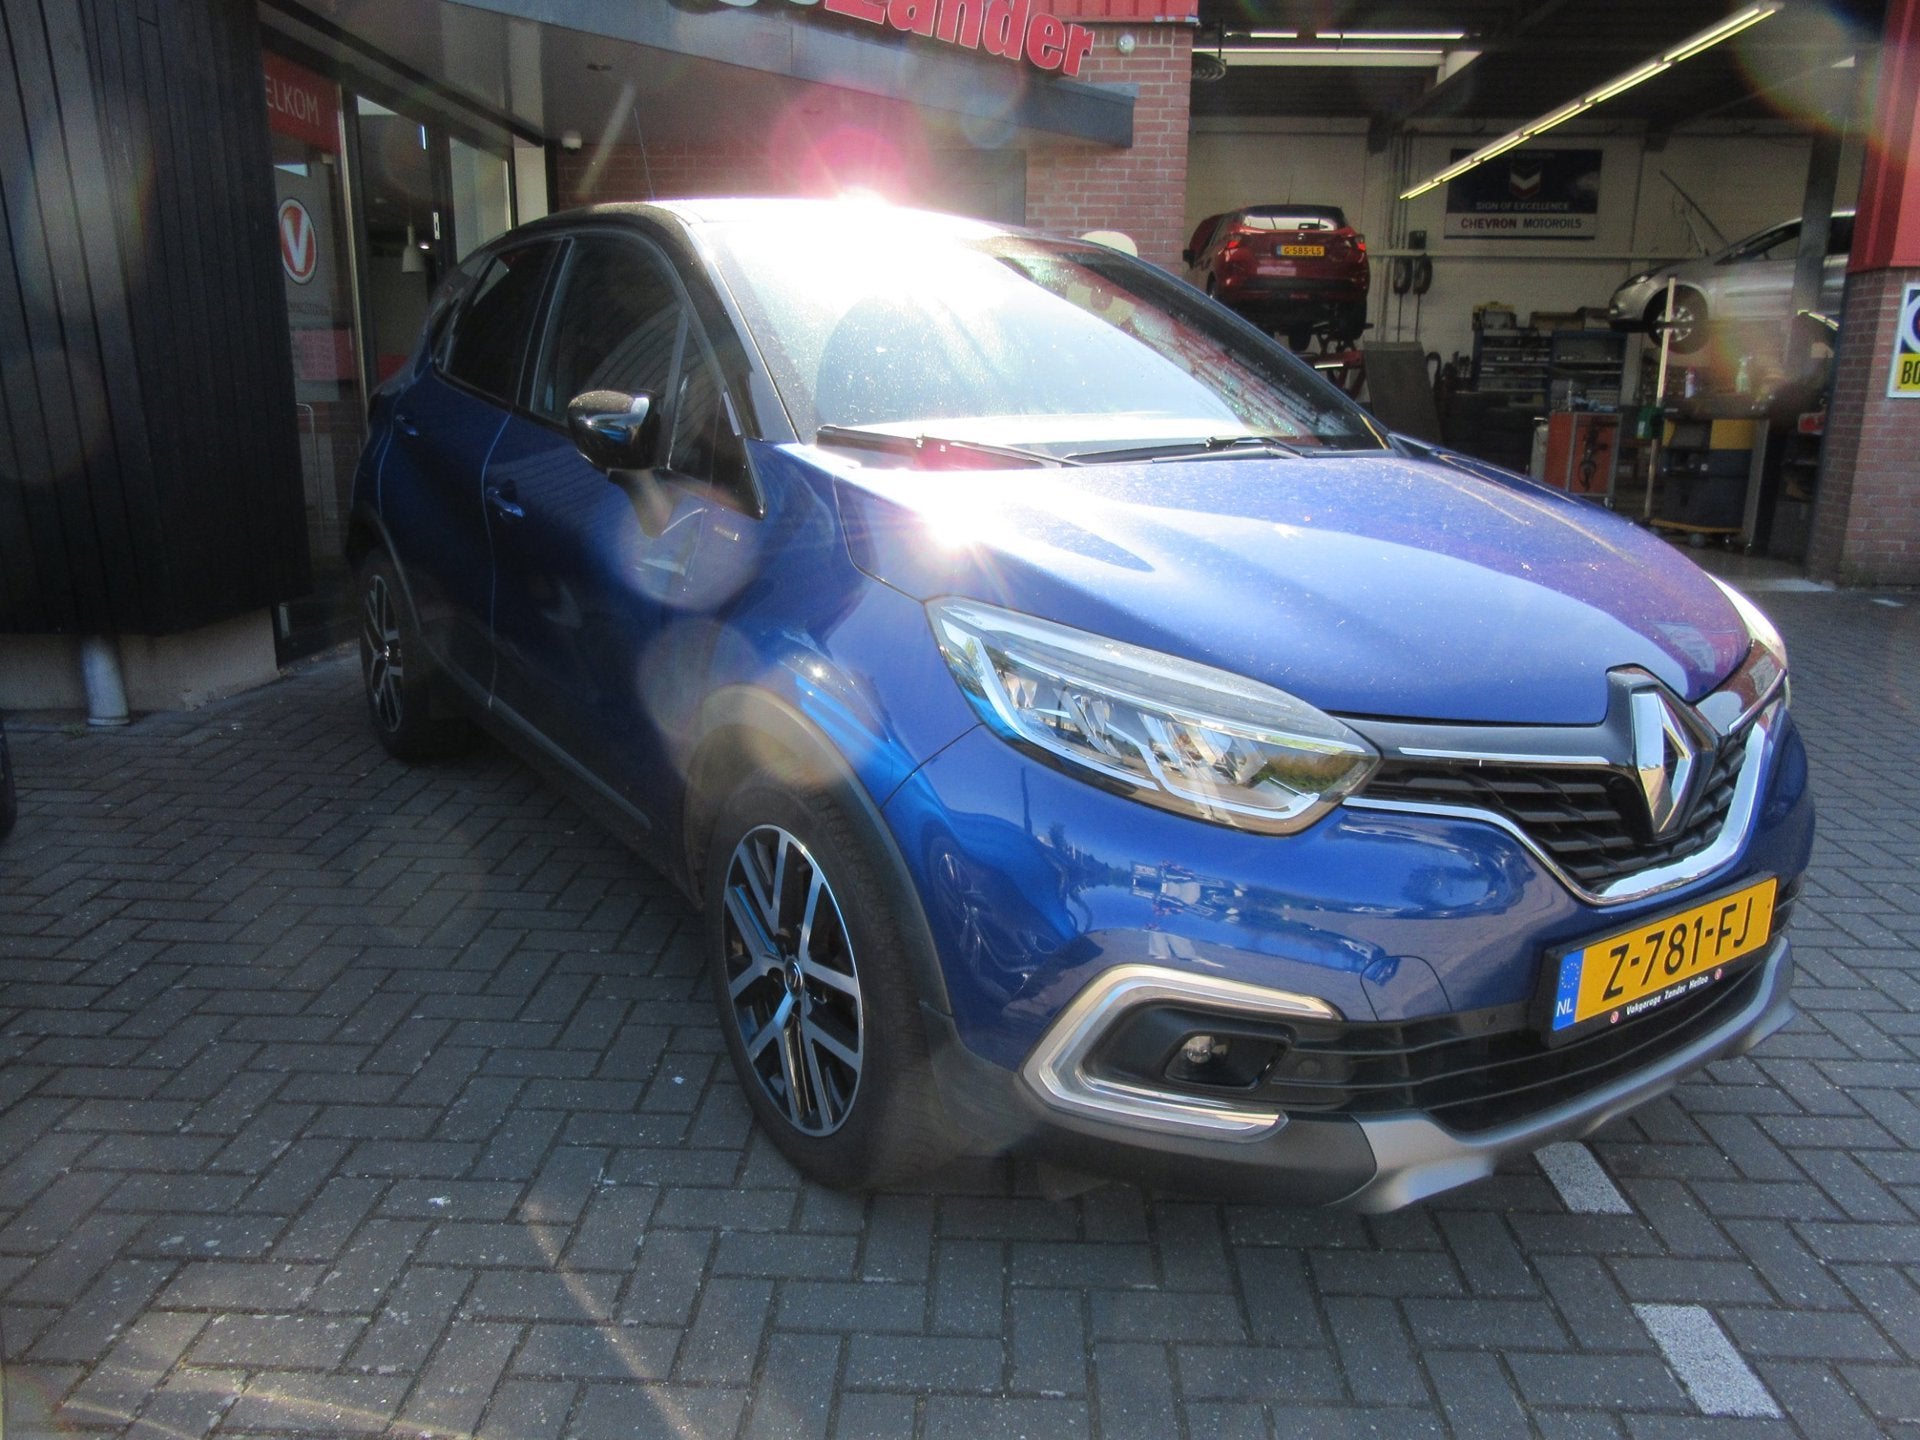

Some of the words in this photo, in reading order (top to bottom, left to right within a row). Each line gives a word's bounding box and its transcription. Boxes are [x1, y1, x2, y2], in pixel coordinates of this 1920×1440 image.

[1460, 218, 1517, 229] CHEVRON
[1523, 218, 1582, 229] MOTOROILS
[1601, 897, 1753, 1001] Z-781-FJ
[1556, 998, 1573, 1018] NL
